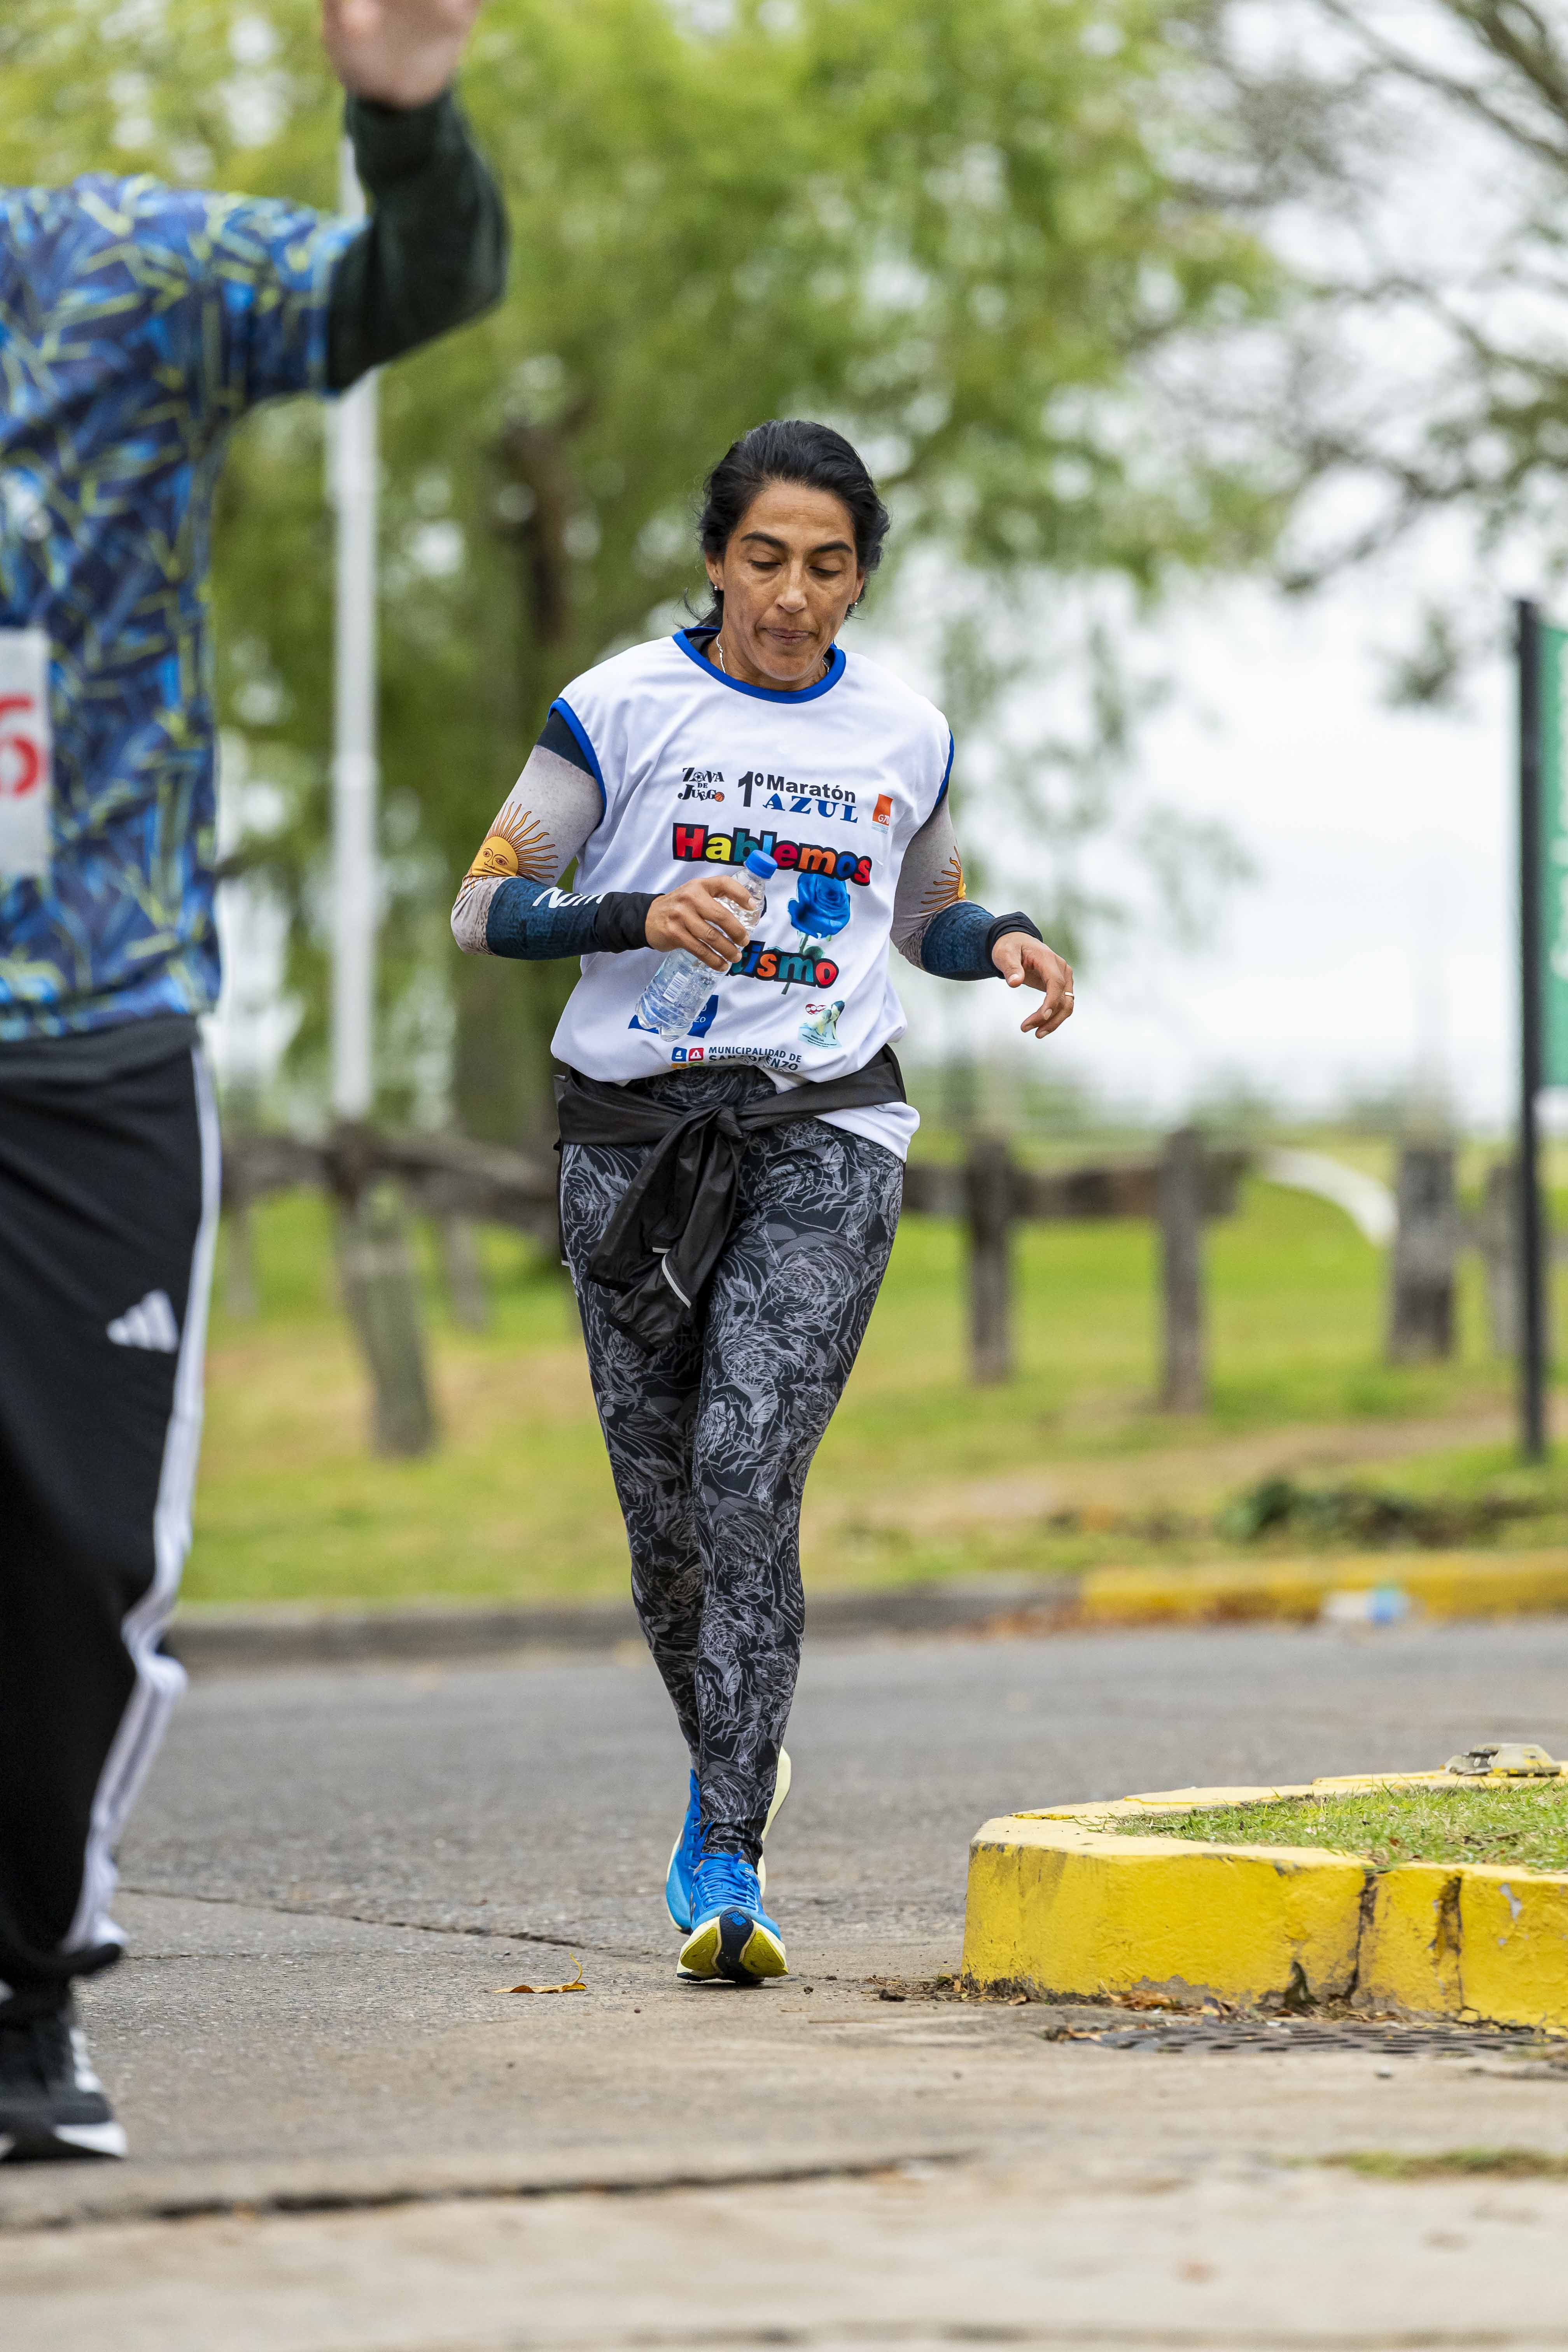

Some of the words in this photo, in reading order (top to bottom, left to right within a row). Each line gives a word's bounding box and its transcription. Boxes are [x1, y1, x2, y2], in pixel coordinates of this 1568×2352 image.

[682, 767, 724, 783] ZONA
[677, 784, 724, 802] JUEGO
[767, 774, 856, 803] Maratón
[762, 793, 858, 823] AZUL
[673, 822, 872, 886] Hablemos
[725, 940, 839, 989] tismo
[709, 1047, 786, 1058] MUNICIPALIDAD
[789, 1053, 802, 1063] DE
[740, 1055, 798, 1071] OENZO
